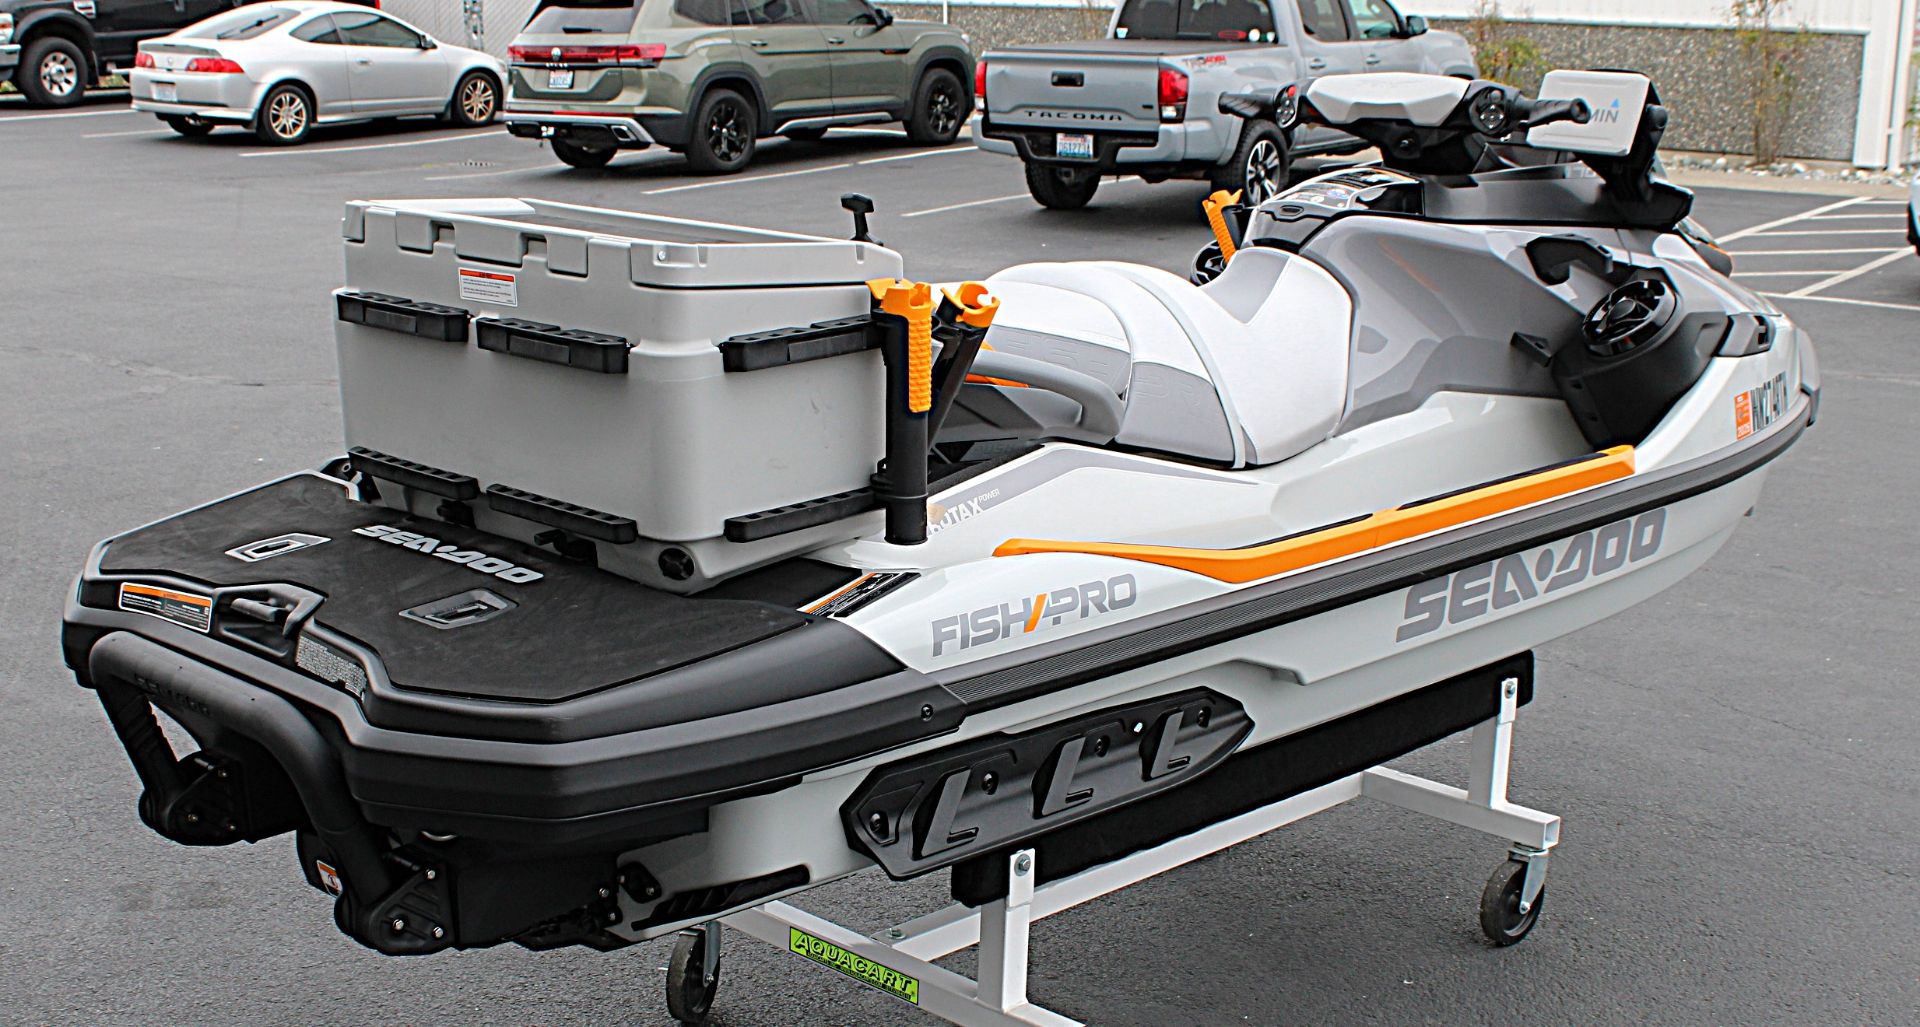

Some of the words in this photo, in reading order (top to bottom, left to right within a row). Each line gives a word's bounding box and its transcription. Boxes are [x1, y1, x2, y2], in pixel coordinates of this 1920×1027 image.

[1024, 110, 1122, 121] TACOMA
[1590, 108, 1619, 123] MIN
[978, 488, 1001, 503] POWER
[794, 933, 913, 992] AQUACART
